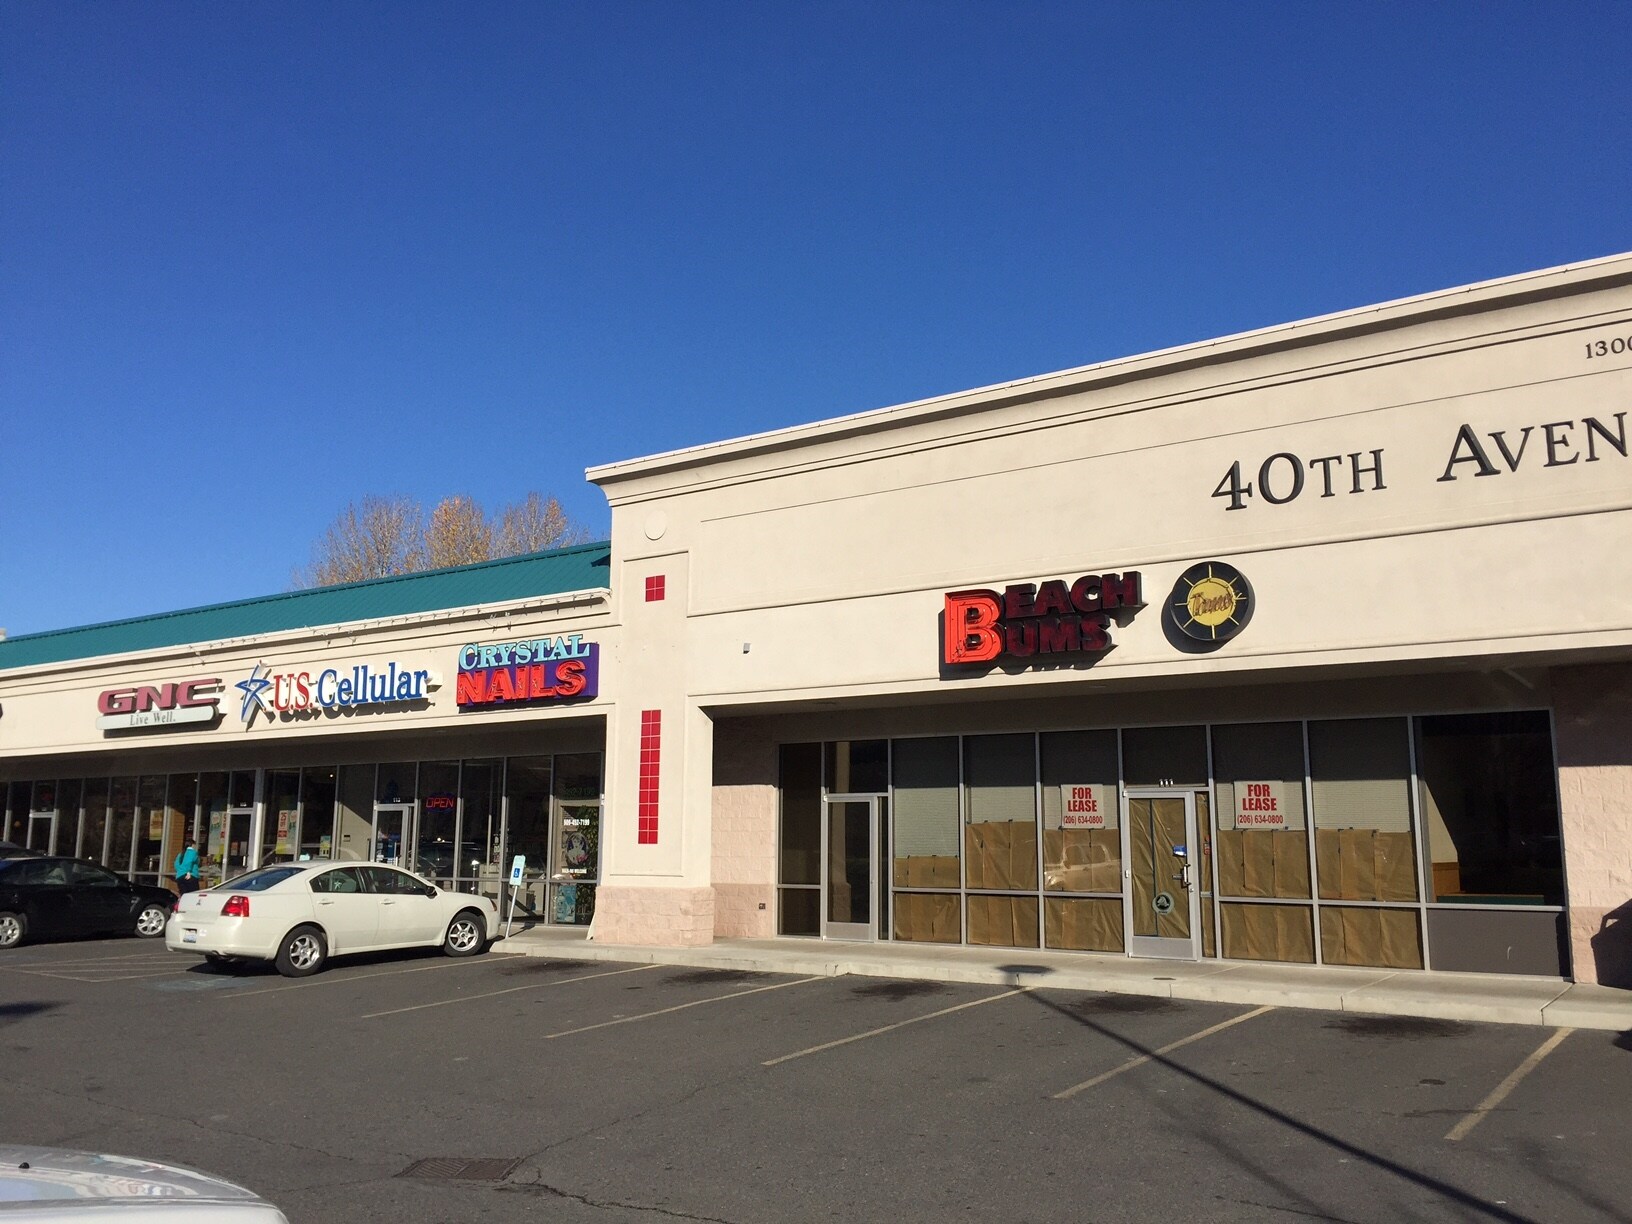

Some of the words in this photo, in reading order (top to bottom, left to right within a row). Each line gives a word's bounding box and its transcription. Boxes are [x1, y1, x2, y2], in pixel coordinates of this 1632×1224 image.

[1210, 448, 1388, 511] 40TH
[1436, 412, 1628, 483] AVEN
[458, 634, 591, 671] CRYSTAL
[273, 671, 314, 711] U.S.
[317, 662, 428, 708] Cellular
[456, 660, 587, 706] NAILS
[97, 678, 222, 715] GNC
[130, 713, 149, 726] Live
[153, 711, 176, 724] Well.
[1159, 779, 1174, 787] 111
[1072, 787, 1092, 800] FOR
[1247, 784, 1270, 797] FOR
[425, 797, 454, 808] OPEN
[1067, 800, 1097, 812] LEASE
[1242, 798, 1277, 811] LEASE
[1063, 815, 1077, 825] (206)
[1078, 815, 1103, 825] 634-0800
[1237, 815, 1253, 825] (206)
[1254, 814, 1283, 824] 634-0800
